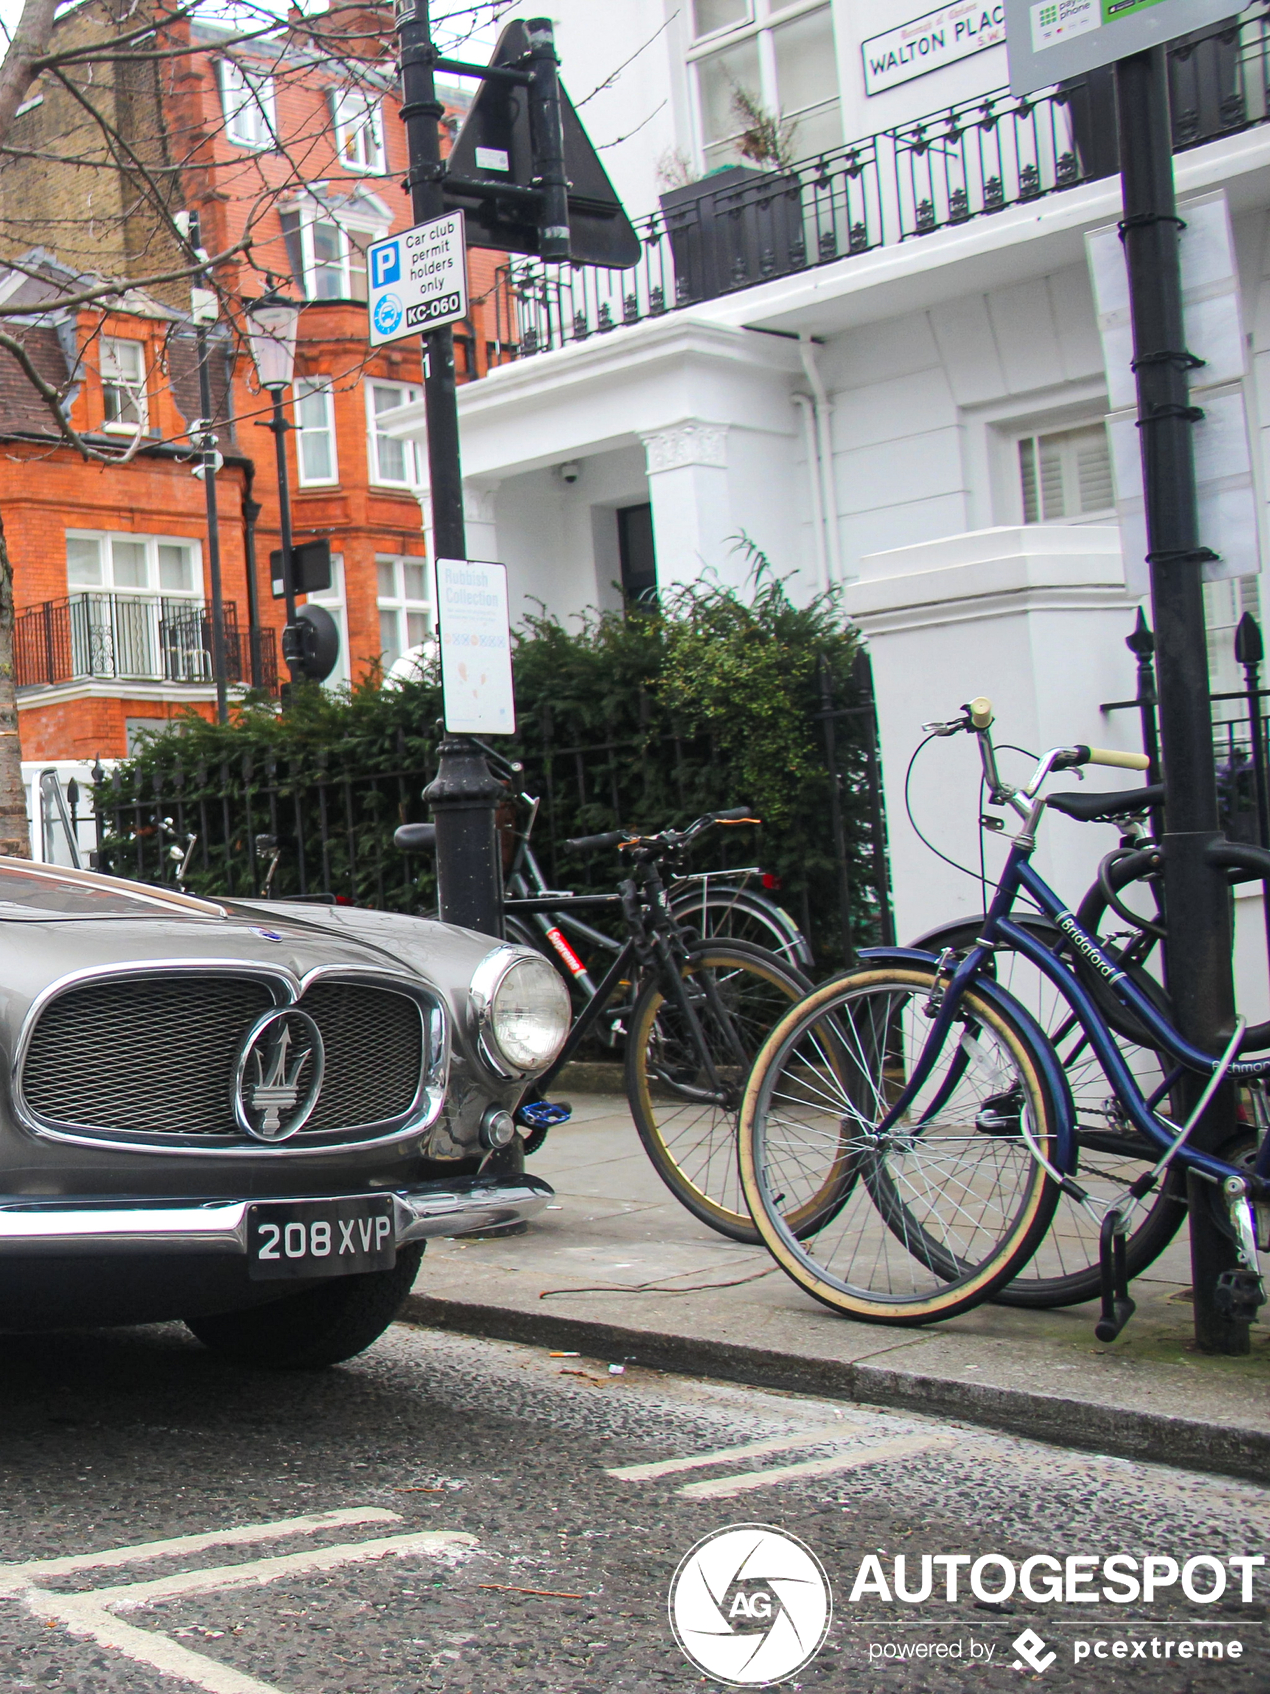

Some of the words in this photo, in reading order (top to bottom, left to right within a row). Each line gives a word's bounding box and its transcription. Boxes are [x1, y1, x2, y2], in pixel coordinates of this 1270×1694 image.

[1060, 2, 1091, 21] phone
[869, 29, 945, 76] WALTON
[954, 5, 1005, 42] PLAC
[405, 233, 426, 249] Car
[429, 221, 455, 239] club
[376, 247, 396, 285] P
[411, 240, 450, 267] permit
[410, 257, 453, 281] holders
[420, 277, 445, 295] only
[407, 294, 459, 325] KC-060
[445, 567, 489, 588] Rubbish
[445, 587, 499, 607] Collection
[547, 931, 581, 971] Supreme
[1060, 917, 1116, 979] Bridgford
[1211, 1059, 1270, 1074] Rchmon
[258, 1221, 332, 1260] 208
[338, 1215, 391, 1255] XVP
